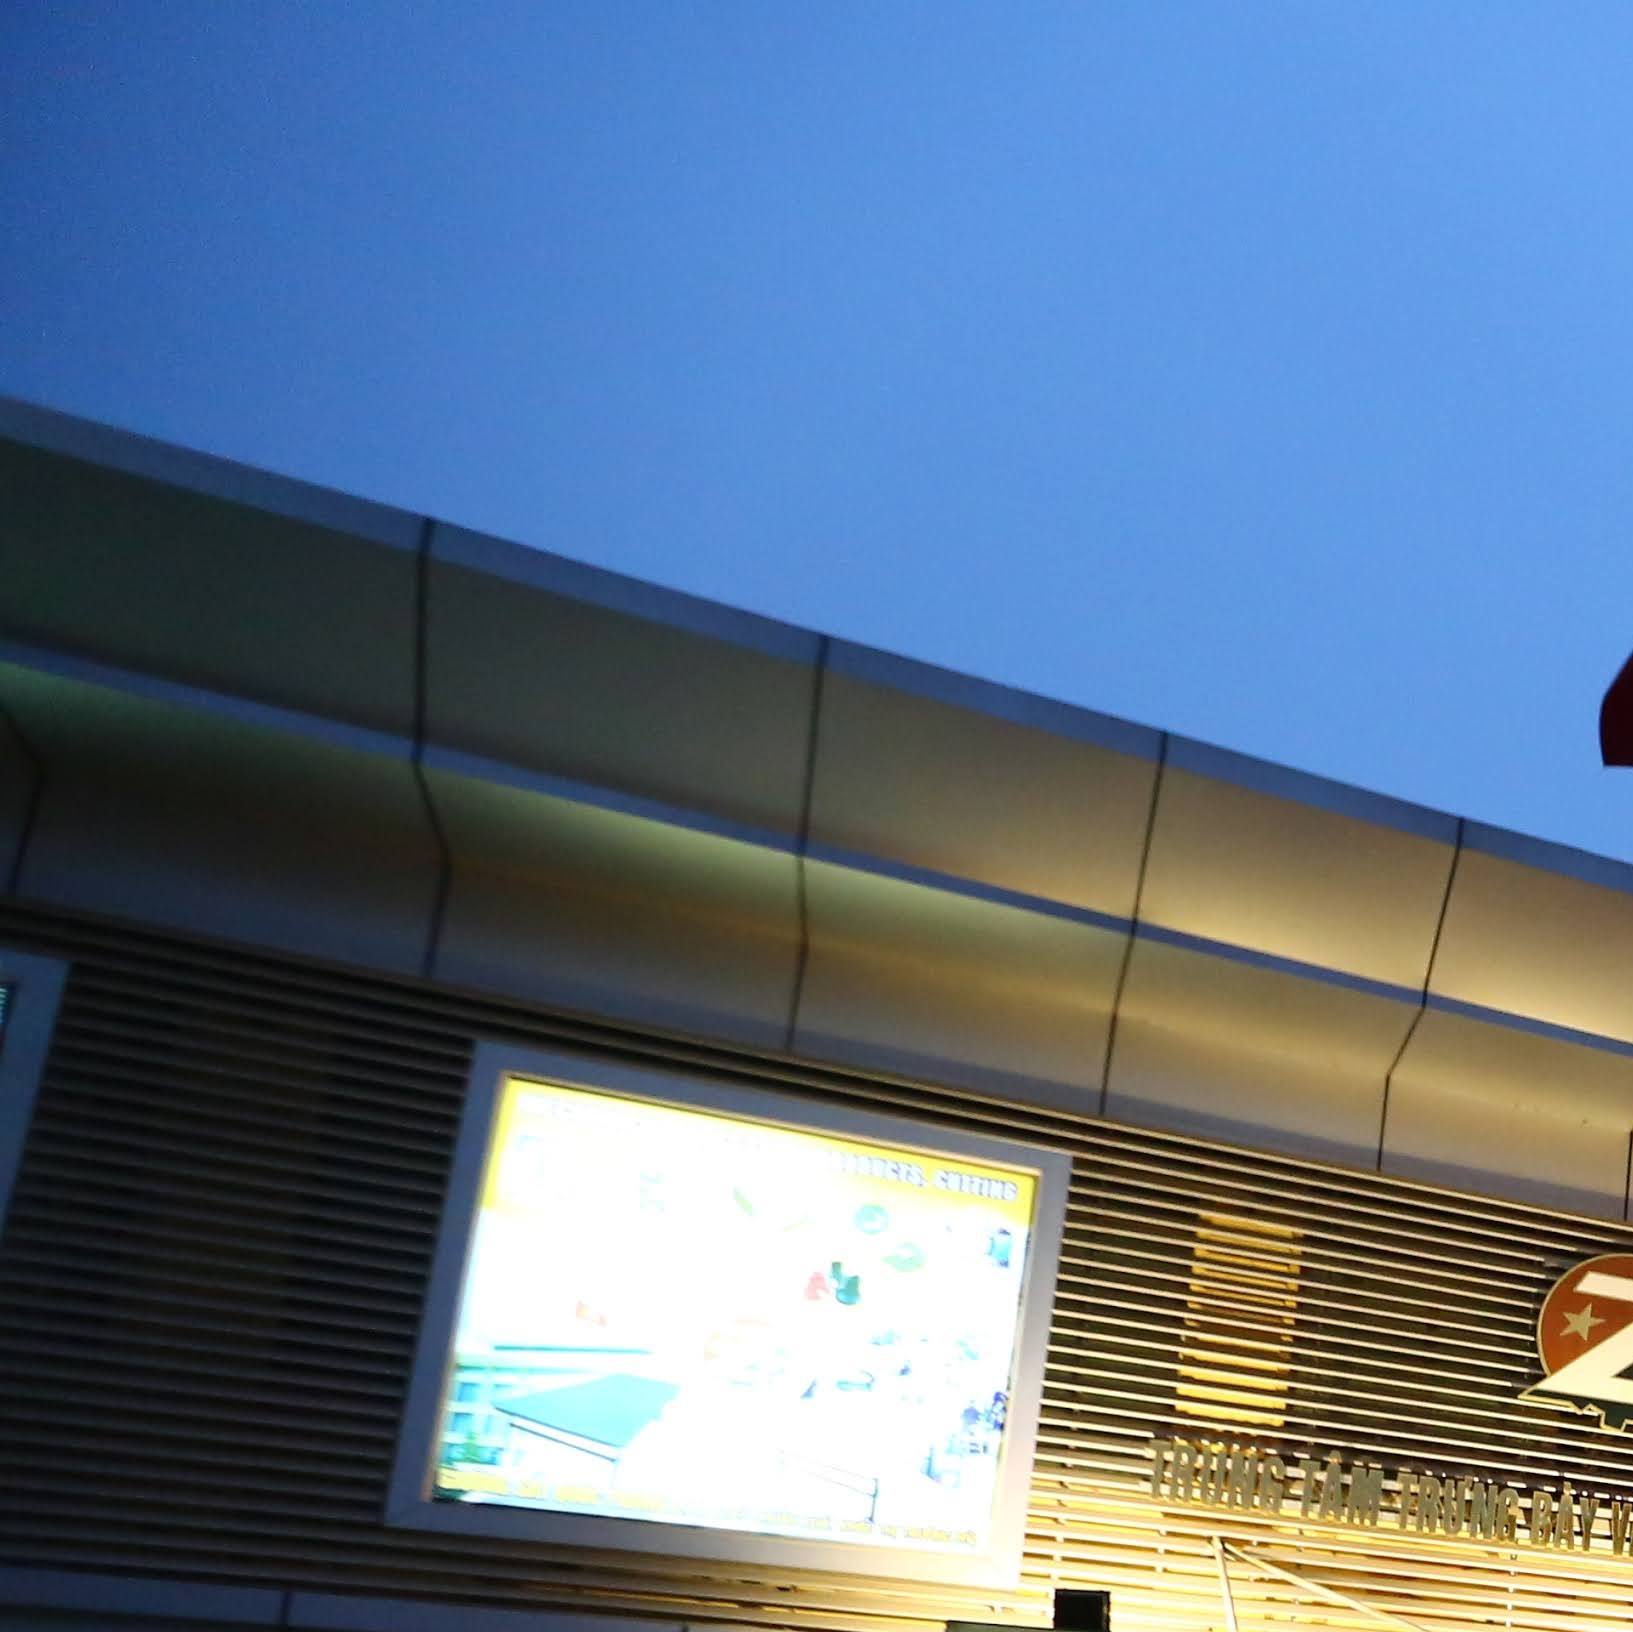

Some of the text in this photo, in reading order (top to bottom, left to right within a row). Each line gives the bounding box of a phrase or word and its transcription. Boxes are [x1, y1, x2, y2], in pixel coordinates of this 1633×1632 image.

[1149, 1438, 1286, 1516] TRUNG
[1300, 1449, 1384, 1527] TÂM
[1531, 1481, 1600, 1552] BÀY
